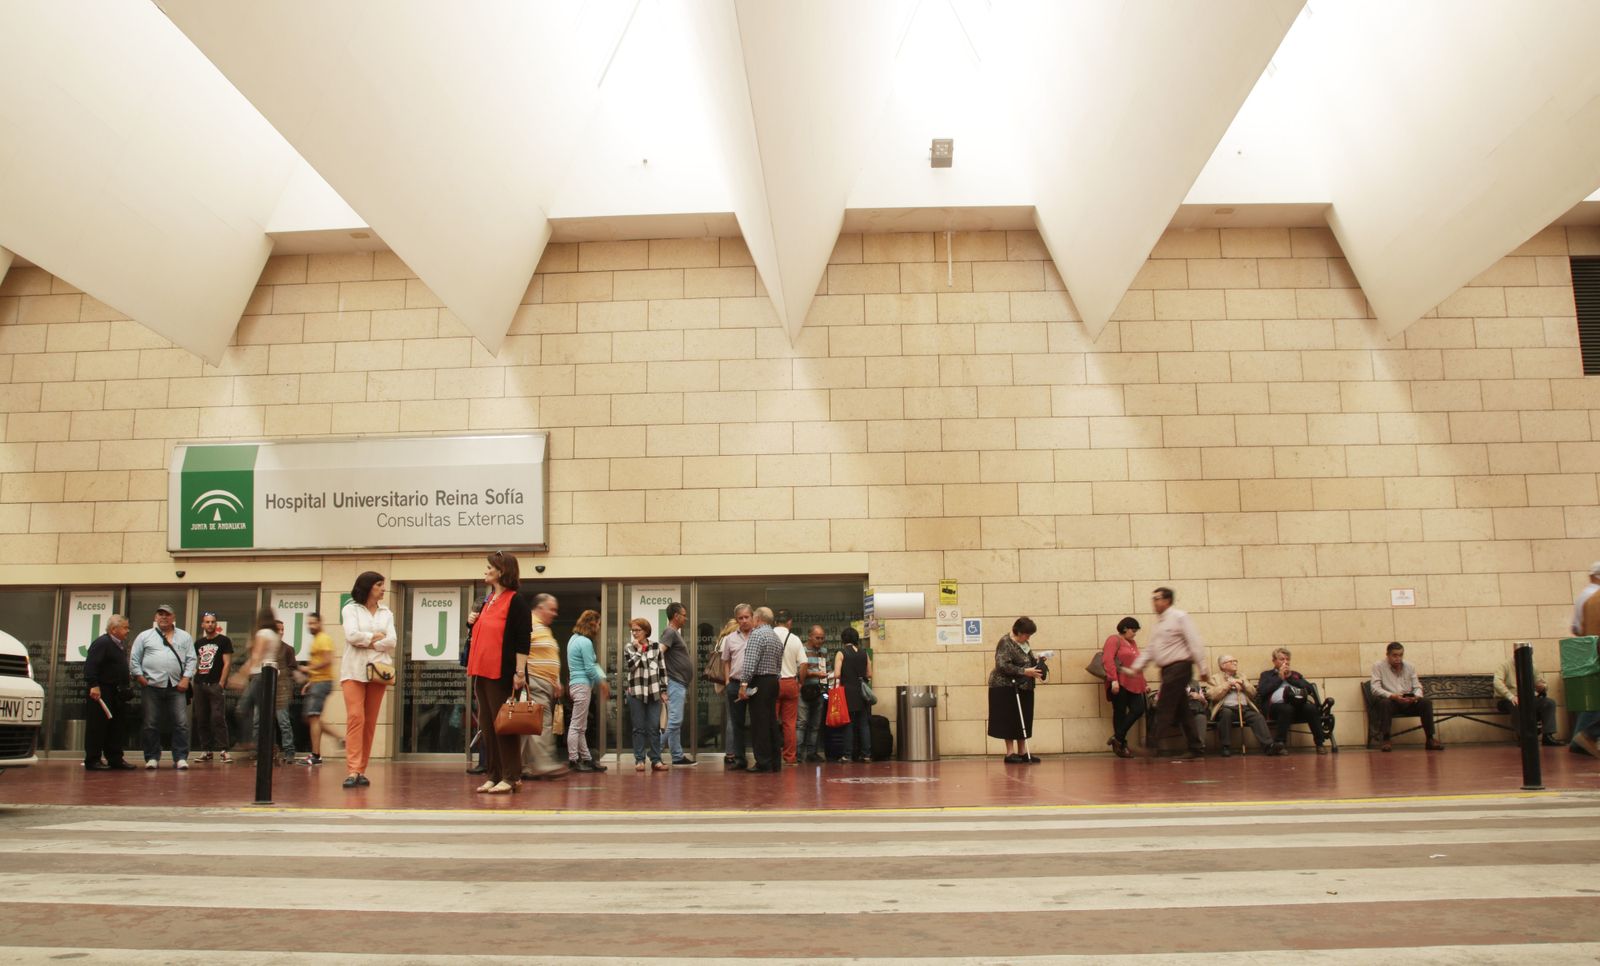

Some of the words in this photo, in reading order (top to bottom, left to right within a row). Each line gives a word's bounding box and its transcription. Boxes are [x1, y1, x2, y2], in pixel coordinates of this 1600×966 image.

[265, 492, 326, 512] Hospital
[333, 490, 428, 508] Universitario
[435, 489, 478, 506] Reina
[485, 488, 523, 505] Sofía
[377, 512, 451, 527] Consultas
[457, 511, 524, 526] Externas
[190, 523, 207, 531] JUNTA
[77, 601, 106, 611] Acceso
[278, 599, 309, 609] Acceso
[421, 597, 452, 608] Acceso
[640, 595, 672, 605] Acceso
[78, 613, 101, 658] J
[424, 611, 448, 657] J
[26, 700, 41, 718] SP
